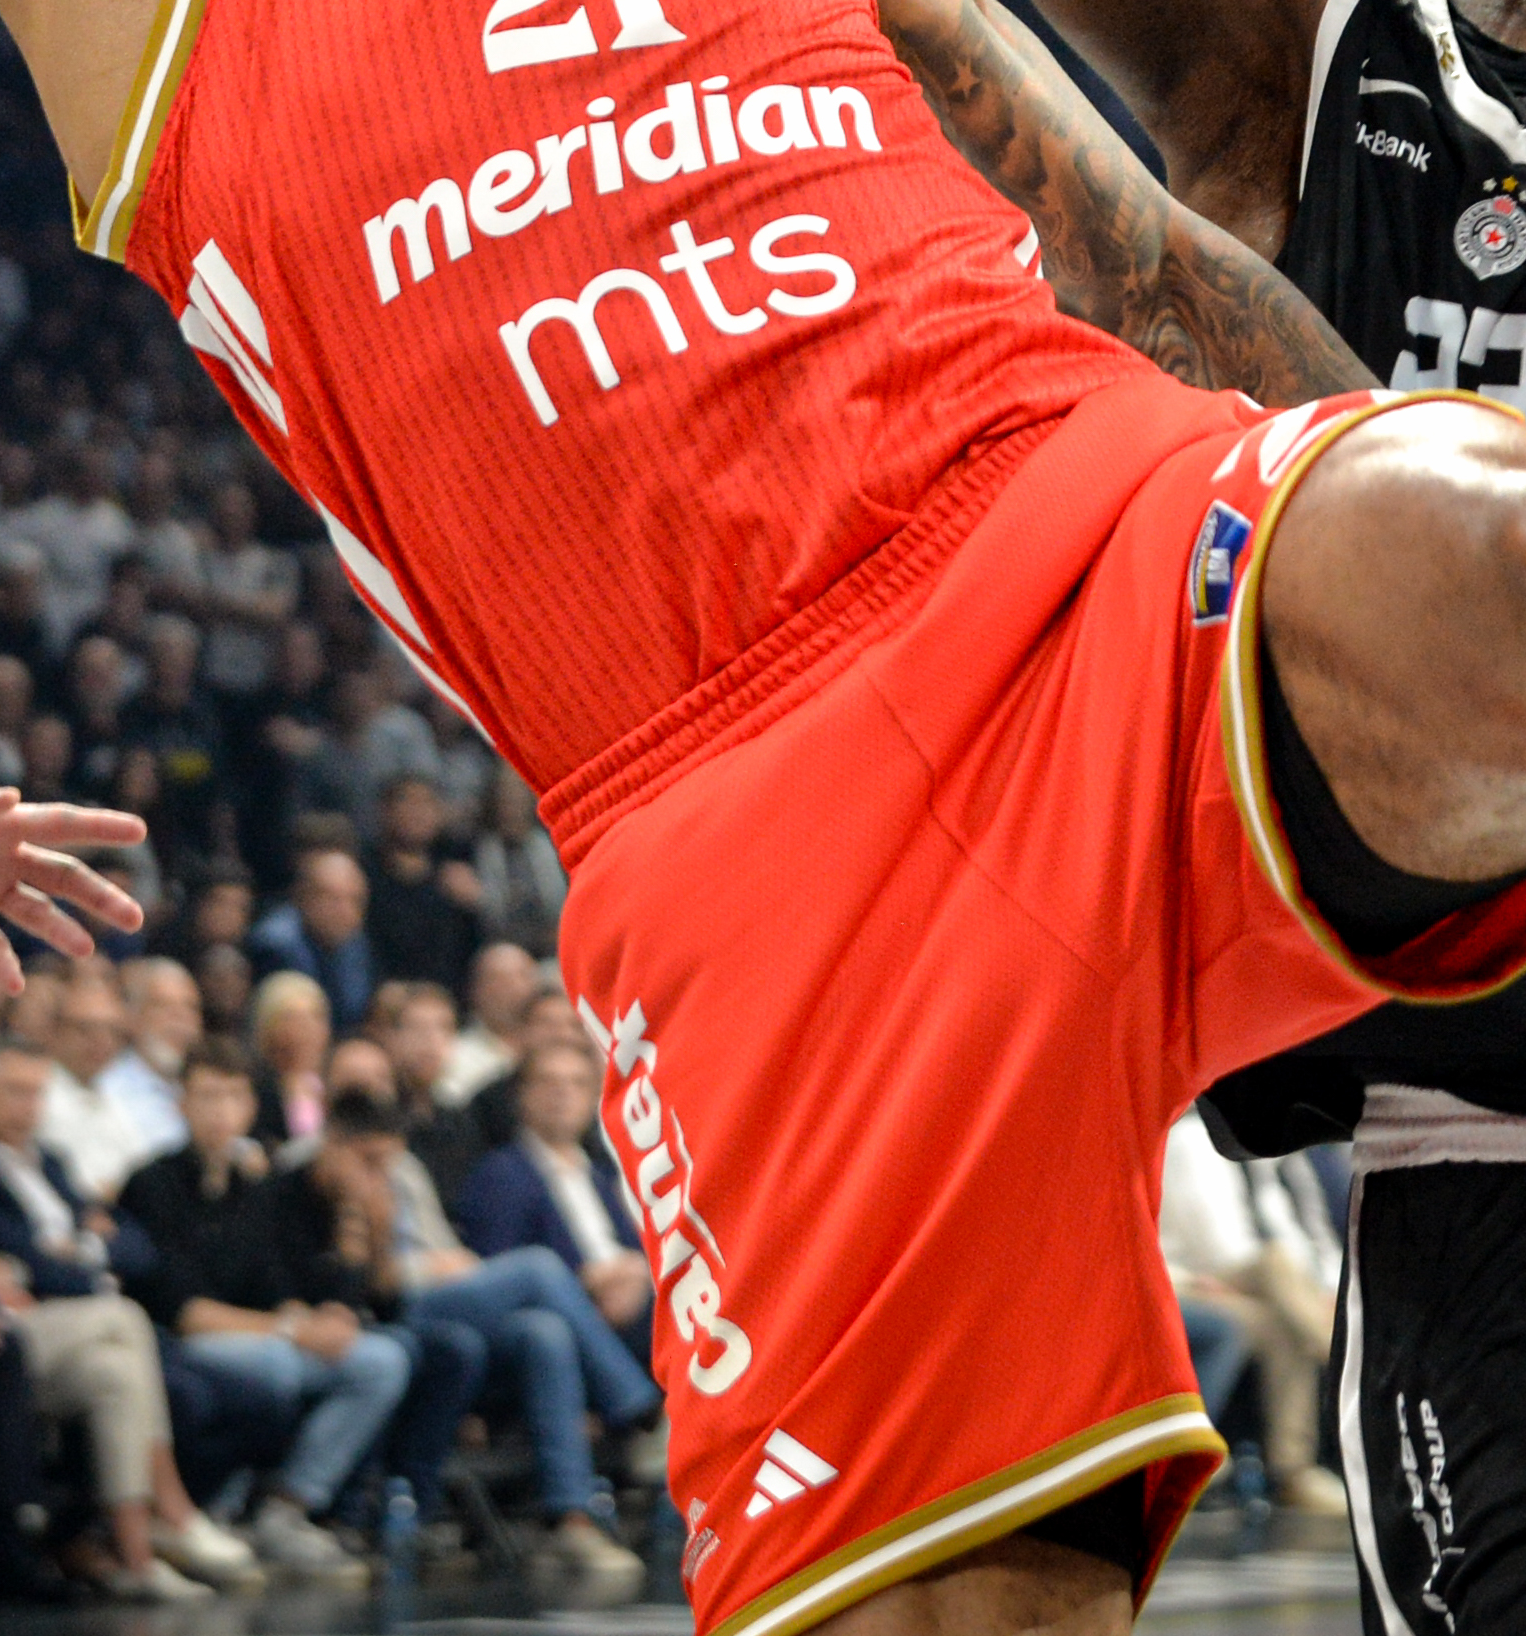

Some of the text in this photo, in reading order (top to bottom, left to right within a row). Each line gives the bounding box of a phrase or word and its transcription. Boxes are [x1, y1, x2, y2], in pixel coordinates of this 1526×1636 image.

[362, 74, 882, 305] meridian
[1356, 121, 1432, 173] kBank
[497, 213, 857, 428] mts
